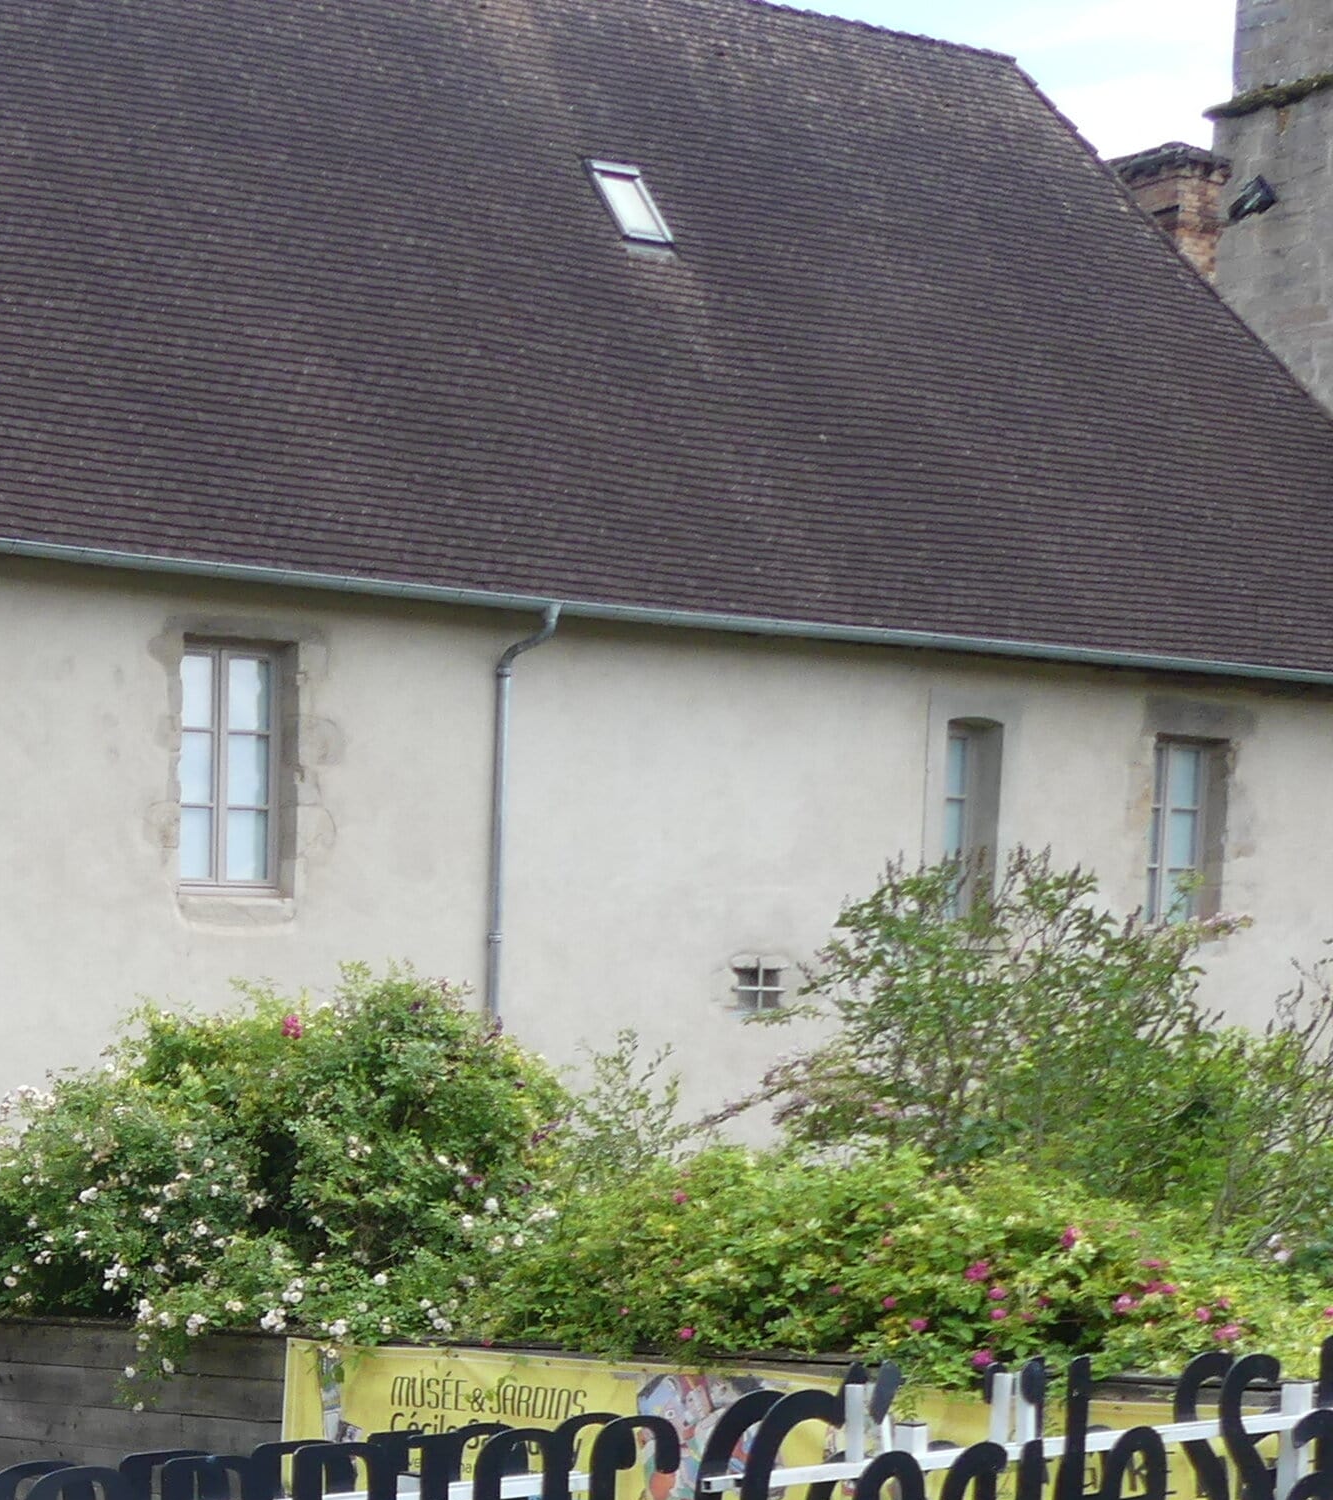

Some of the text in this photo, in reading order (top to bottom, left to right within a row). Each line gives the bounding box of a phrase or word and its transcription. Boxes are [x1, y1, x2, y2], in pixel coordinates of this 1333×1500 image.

[390, 1371, 588, 1421] MUSÉE & JARDINS
